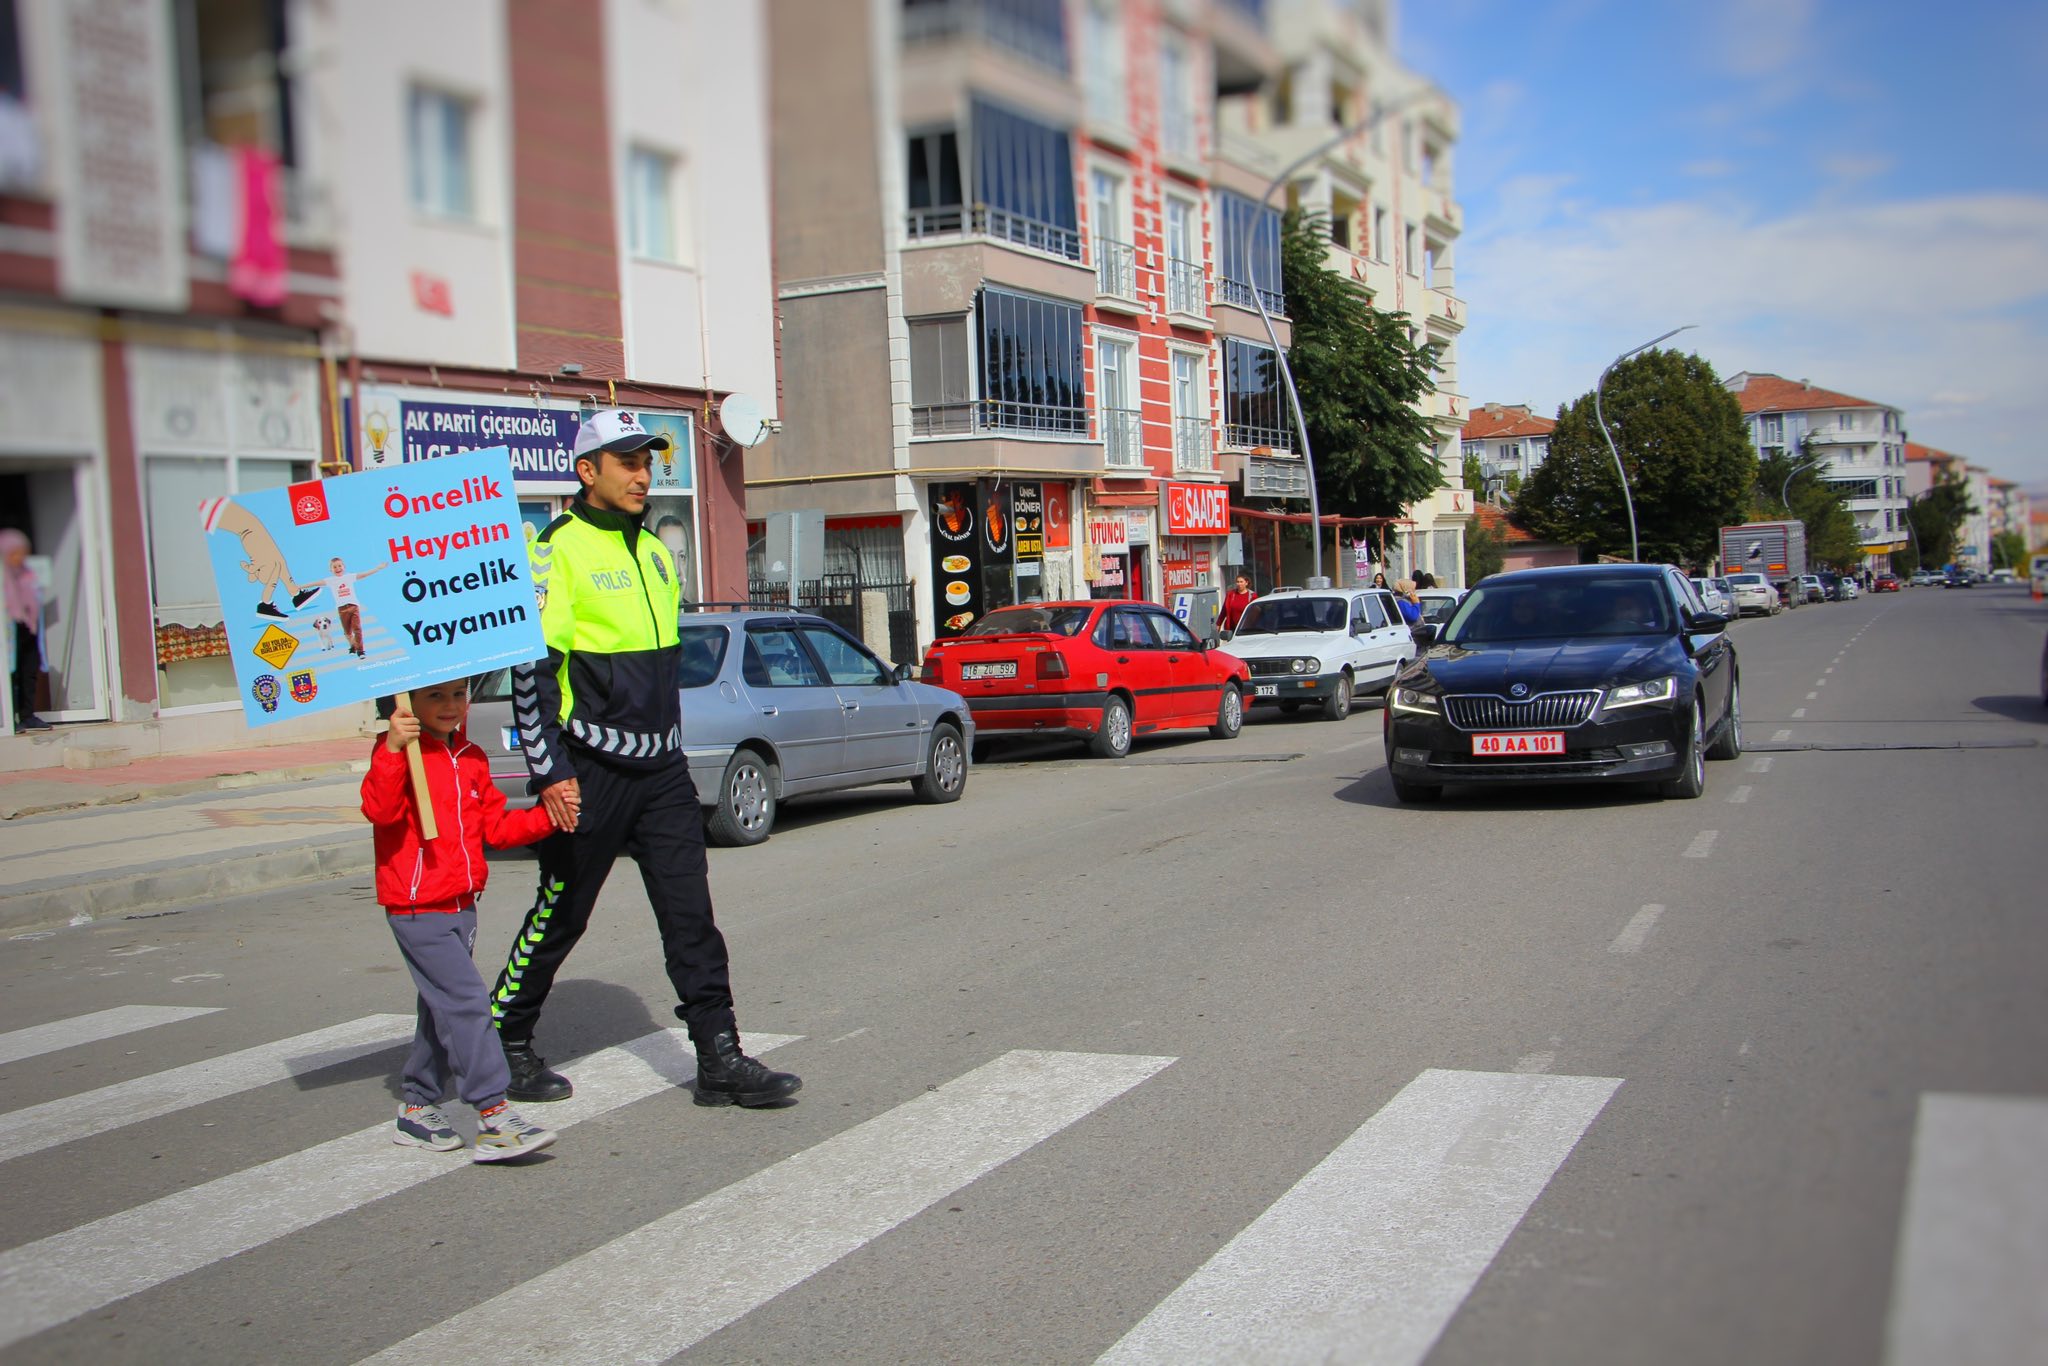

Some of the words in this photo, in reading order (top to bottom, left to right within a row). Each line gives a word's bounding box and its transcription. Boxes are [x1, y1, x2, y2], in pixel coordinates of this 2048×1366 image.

[406, 410, 430, 431] AK
[433, 409, 476, 433] PARTİ
[480, 410, 557, 439] ÇİÇEKDAĞI
[384, 475, 503, 518] Öncelik
[1019, 486, 1036, 497] ÜNAL
[1015, 500, 1041, 513] DÖNER
[1185, 487, 1227, 529] SAADET
[387, 523, 510, 563] Hayatın
[1088, 517, 1125, 545] ÜTÜNCÜ
[402, 558, 519, 603] Öncelik
[403, 605, 526, 646] Yayanın
[969, 666, 978, 675] 16
[984, 665, 993, 674] ZU
[1000, 664, 1014, 674] 592
[1261, 687, 1274, 695] 172
[1481, 738, 1500, 752] 40
[1505, 737, 1529, 752] AA
[1533, 736, 1557, 751] 101
